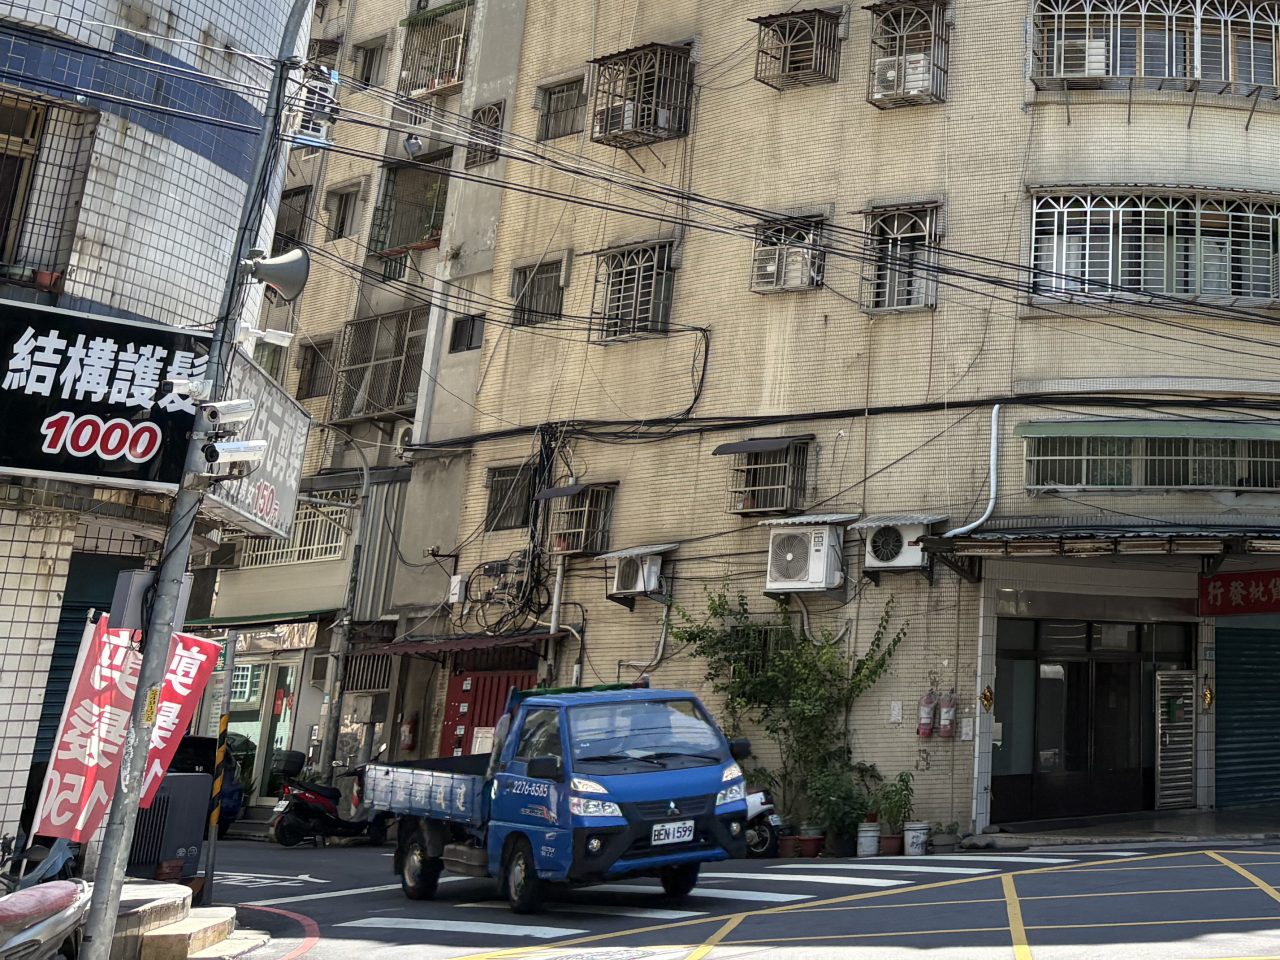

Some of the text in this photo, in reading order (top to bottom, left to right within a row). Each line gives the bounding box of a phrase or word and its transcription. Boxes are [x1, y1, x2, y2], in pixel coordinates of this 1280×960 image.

[2, 326, 210, 416] 結構護髮
[41, 410, 162, 464] 1000
[512, 781, 548, 797] 2276-8585
